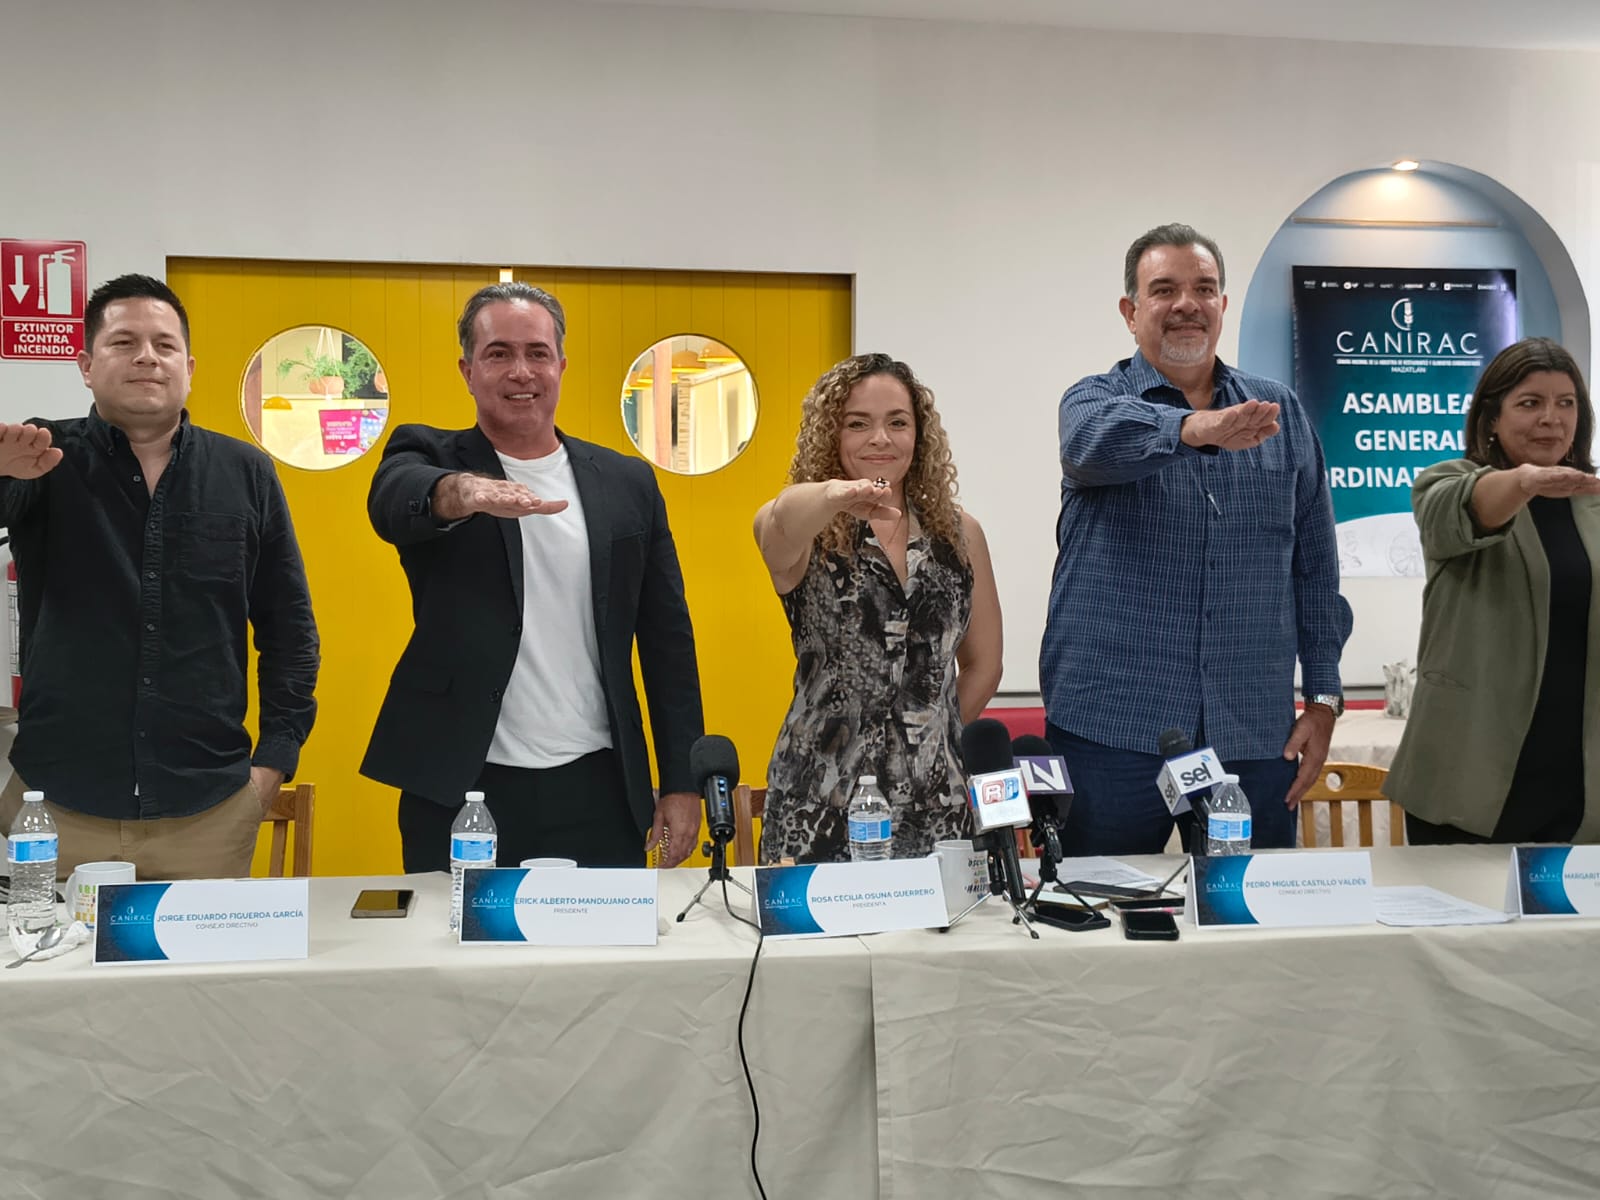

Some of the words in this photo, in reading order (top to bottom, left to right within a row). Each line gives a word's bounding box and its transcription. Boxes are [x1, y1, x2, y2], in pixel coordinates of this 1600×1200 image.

[14, 322, 74, 334] EXTINTOR
[19, 333, 69, 344] CONTRA
[1336, 331, 1479, 354] CANIRAC
[13, 344, 75, 355] INCENDIO
[1354, 429, 1468, 452] GENERAL
[1180, 762, 1212, 786] sel
[1246, 881, 1271, 889] PEDRO
[1272, 880, 1300, 888] MIGUEL
[1301, 879, 1337, 887] CASTILLO
[472, 897, 511, 905] CANIRAC
[515, 897, 538, 905] ERICK
[540, 897, 577, 905] ALBERTO
[578, 897, 630, 905] MANDUJANO
[631, 897, 655, 905] CARO
[811, 895, 833, 904] ROSA
[833, 893, 863, 903] CECILIA
[864, 891, 893, 900] OSUNA
[893, 888, 935, 898] GUERRERO
[110, 913, 152, 922] CANIRAC
[157, 914, 185, 922] JORGE
[186, 912, 228, 922] EDUARDO
[229, 911, 271, 920] FIGUEROA
[272, 909, 304, 919] GARCÍA
[195, 922, 225, 930] CONSEJO
